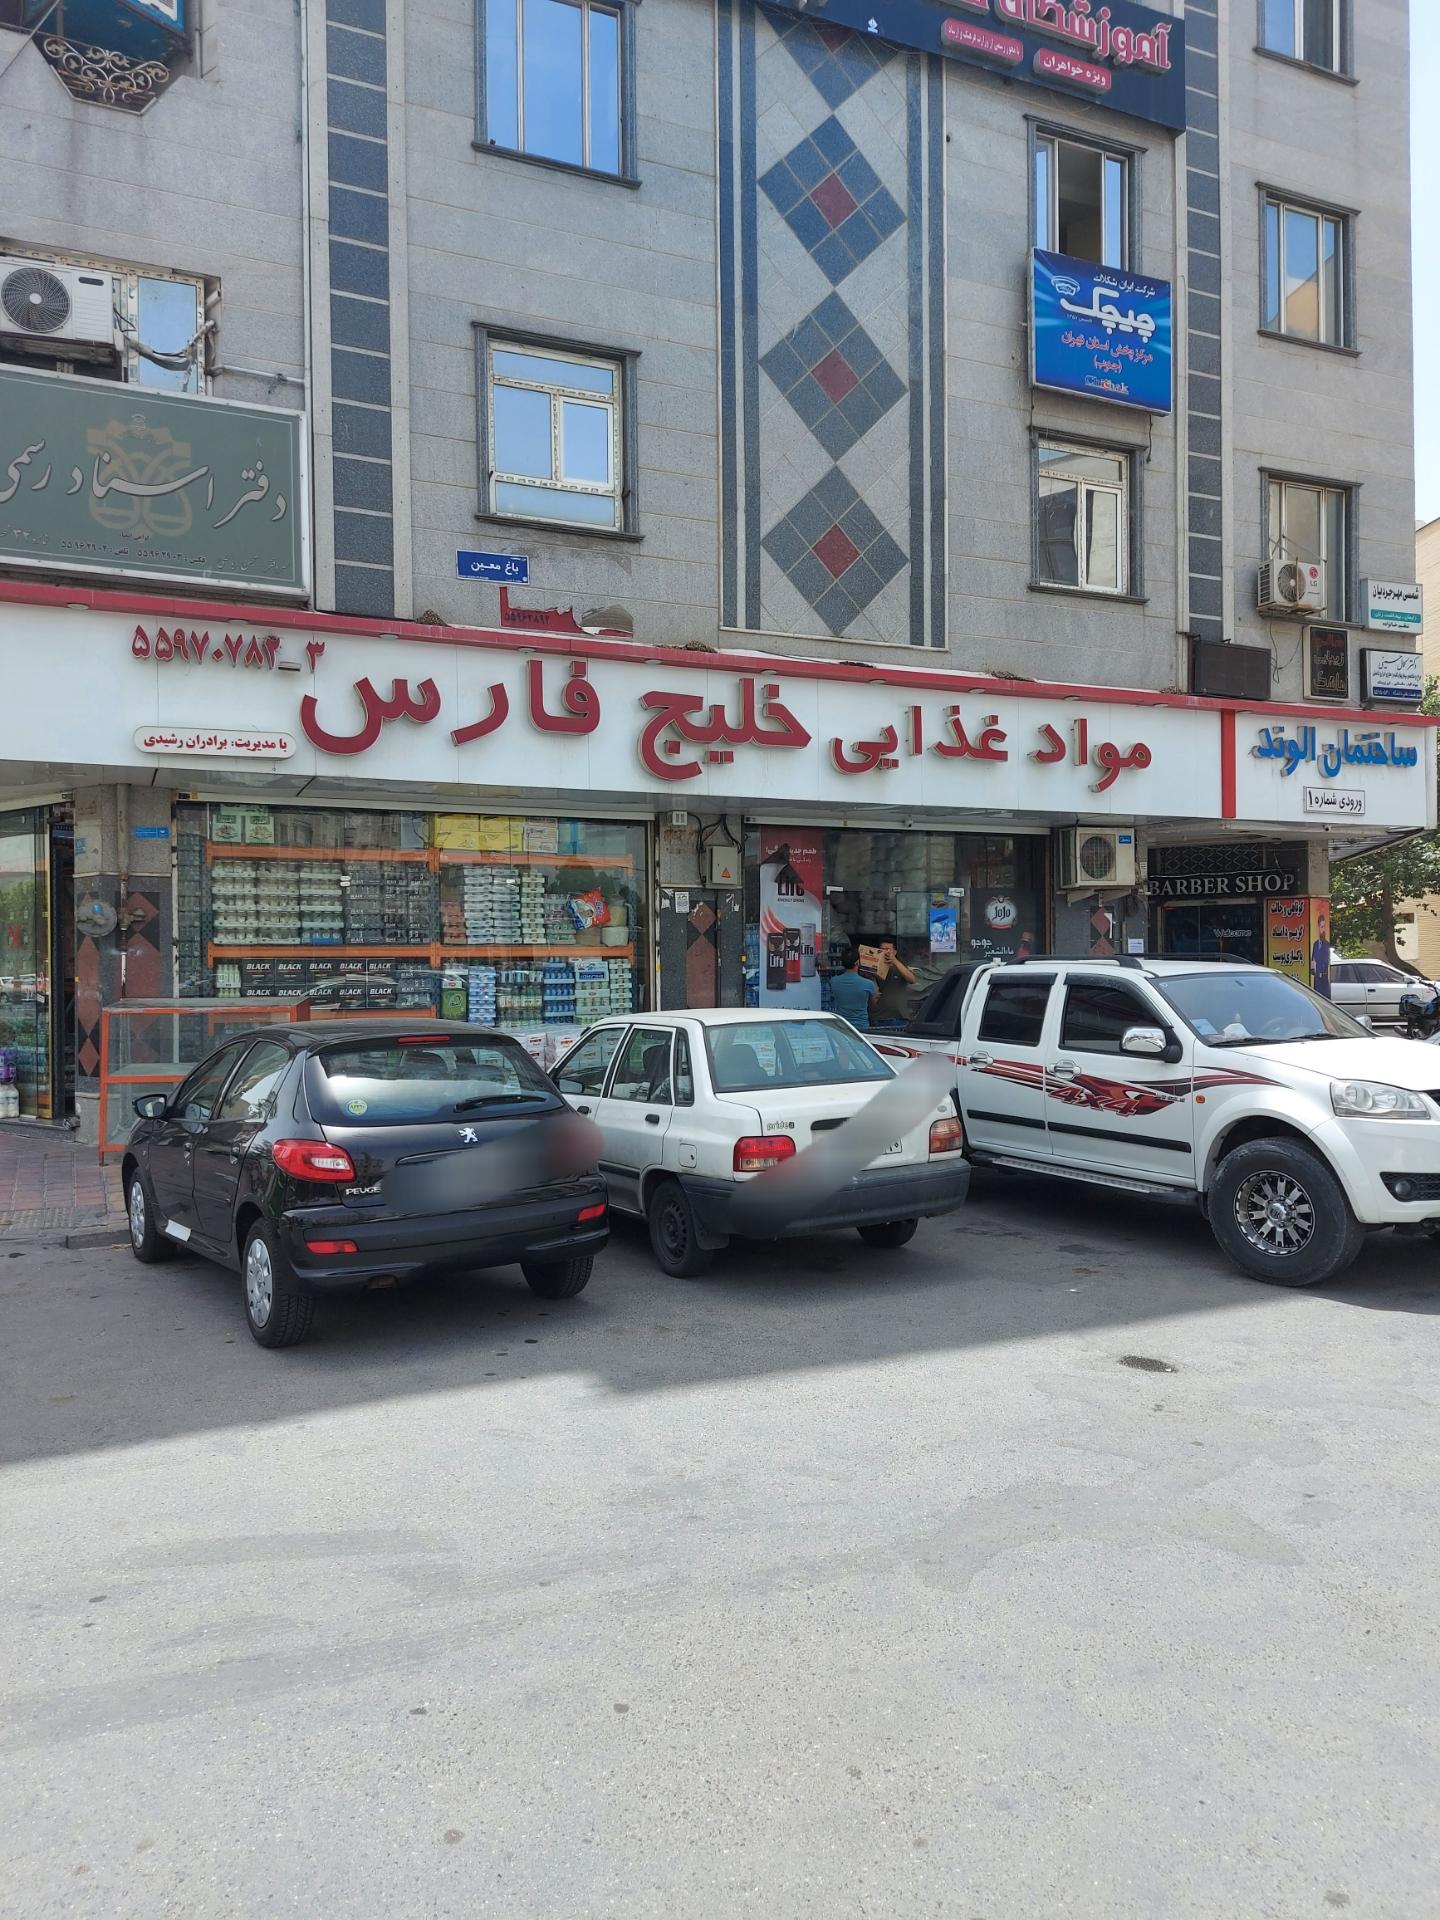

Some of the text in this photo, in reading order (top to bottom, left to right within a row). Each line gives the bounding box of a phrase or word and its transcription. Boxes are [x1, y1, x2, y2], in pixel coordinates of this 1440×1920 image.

[1043, 55, 1106, 86] ویژه خواهران
[1094, 273, 1156, 298] شرکت ایران شکلات
[1060, 286, 1156, 344] چیچک
[1061, 330, 1153, 365] مرکز پخش استان تهران
[0, 438, 288, 529] دفتر اسناد رسمی
[471, 561, 519, 575] باغ معین
[299, 658, 1152, 793] مواد غذایی خلیج فارس
[143, 733, 184, 749] رشیدی
[186, 735, 228, 751] برادران
[279, 737, 287, 753] با
[1252, 726, 1418, 778] ساختمان الوند
[1314, 792, 1337, 810] شماره
[1339, 797, 1363, 812] ورودی
[1150, 874, 1295, 896] BARBER SHOP
[971, 938, 993, 949] جوجو
[309, 962, 332, 970] BLACK
[339, 962, 363, 970] BLACK
[369, 962, 392, 970] BLACK
[769, 953, 784, 968] Life
[246, 988, 271, 996] BLACK
[278, 988, 302, 996] BLACK
[309, 988, 332, 996] BLACK
[339, 988, 362, 996] BLACK
[369, 987, 393, 996] BLACK
